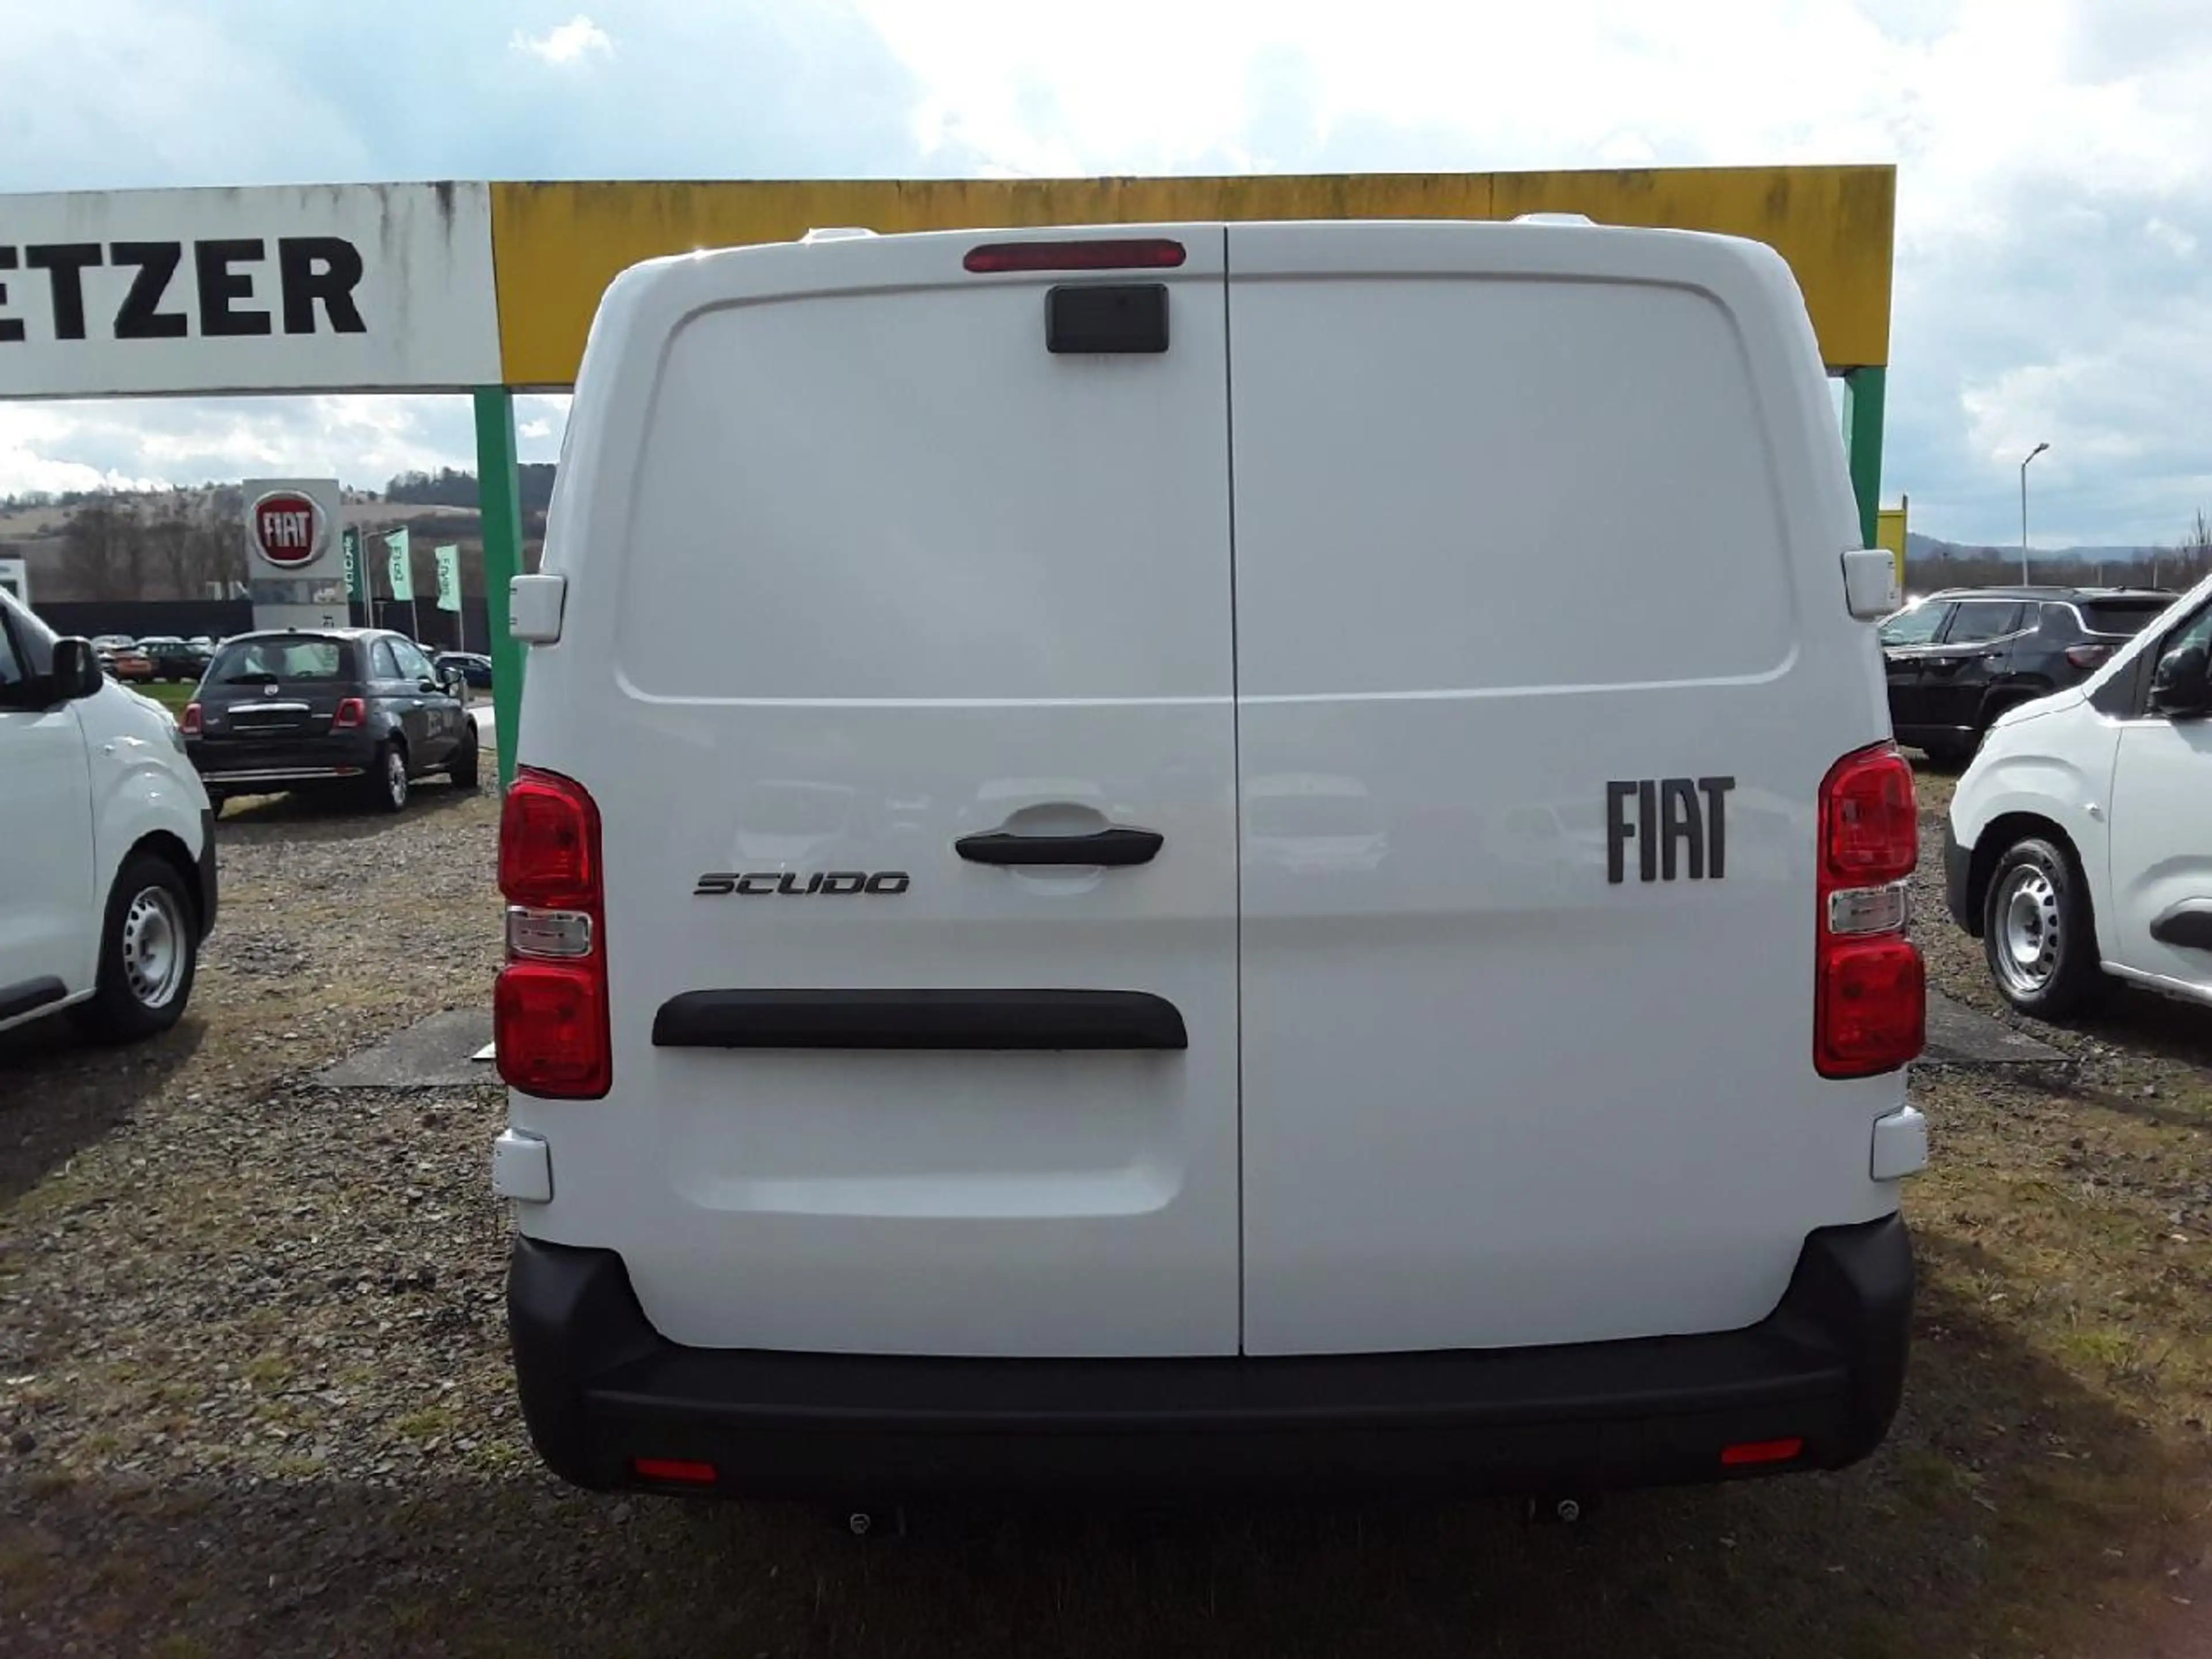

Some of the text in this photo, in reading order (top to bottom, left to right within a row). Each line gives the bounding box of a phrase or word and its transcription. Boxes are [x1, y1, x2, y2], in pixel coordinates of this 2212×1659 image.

[263, 512, 310, 547] FIAT
[1607, 775, 1735, 884] FIAT
[693, 871, 910, 895] SCUDO
